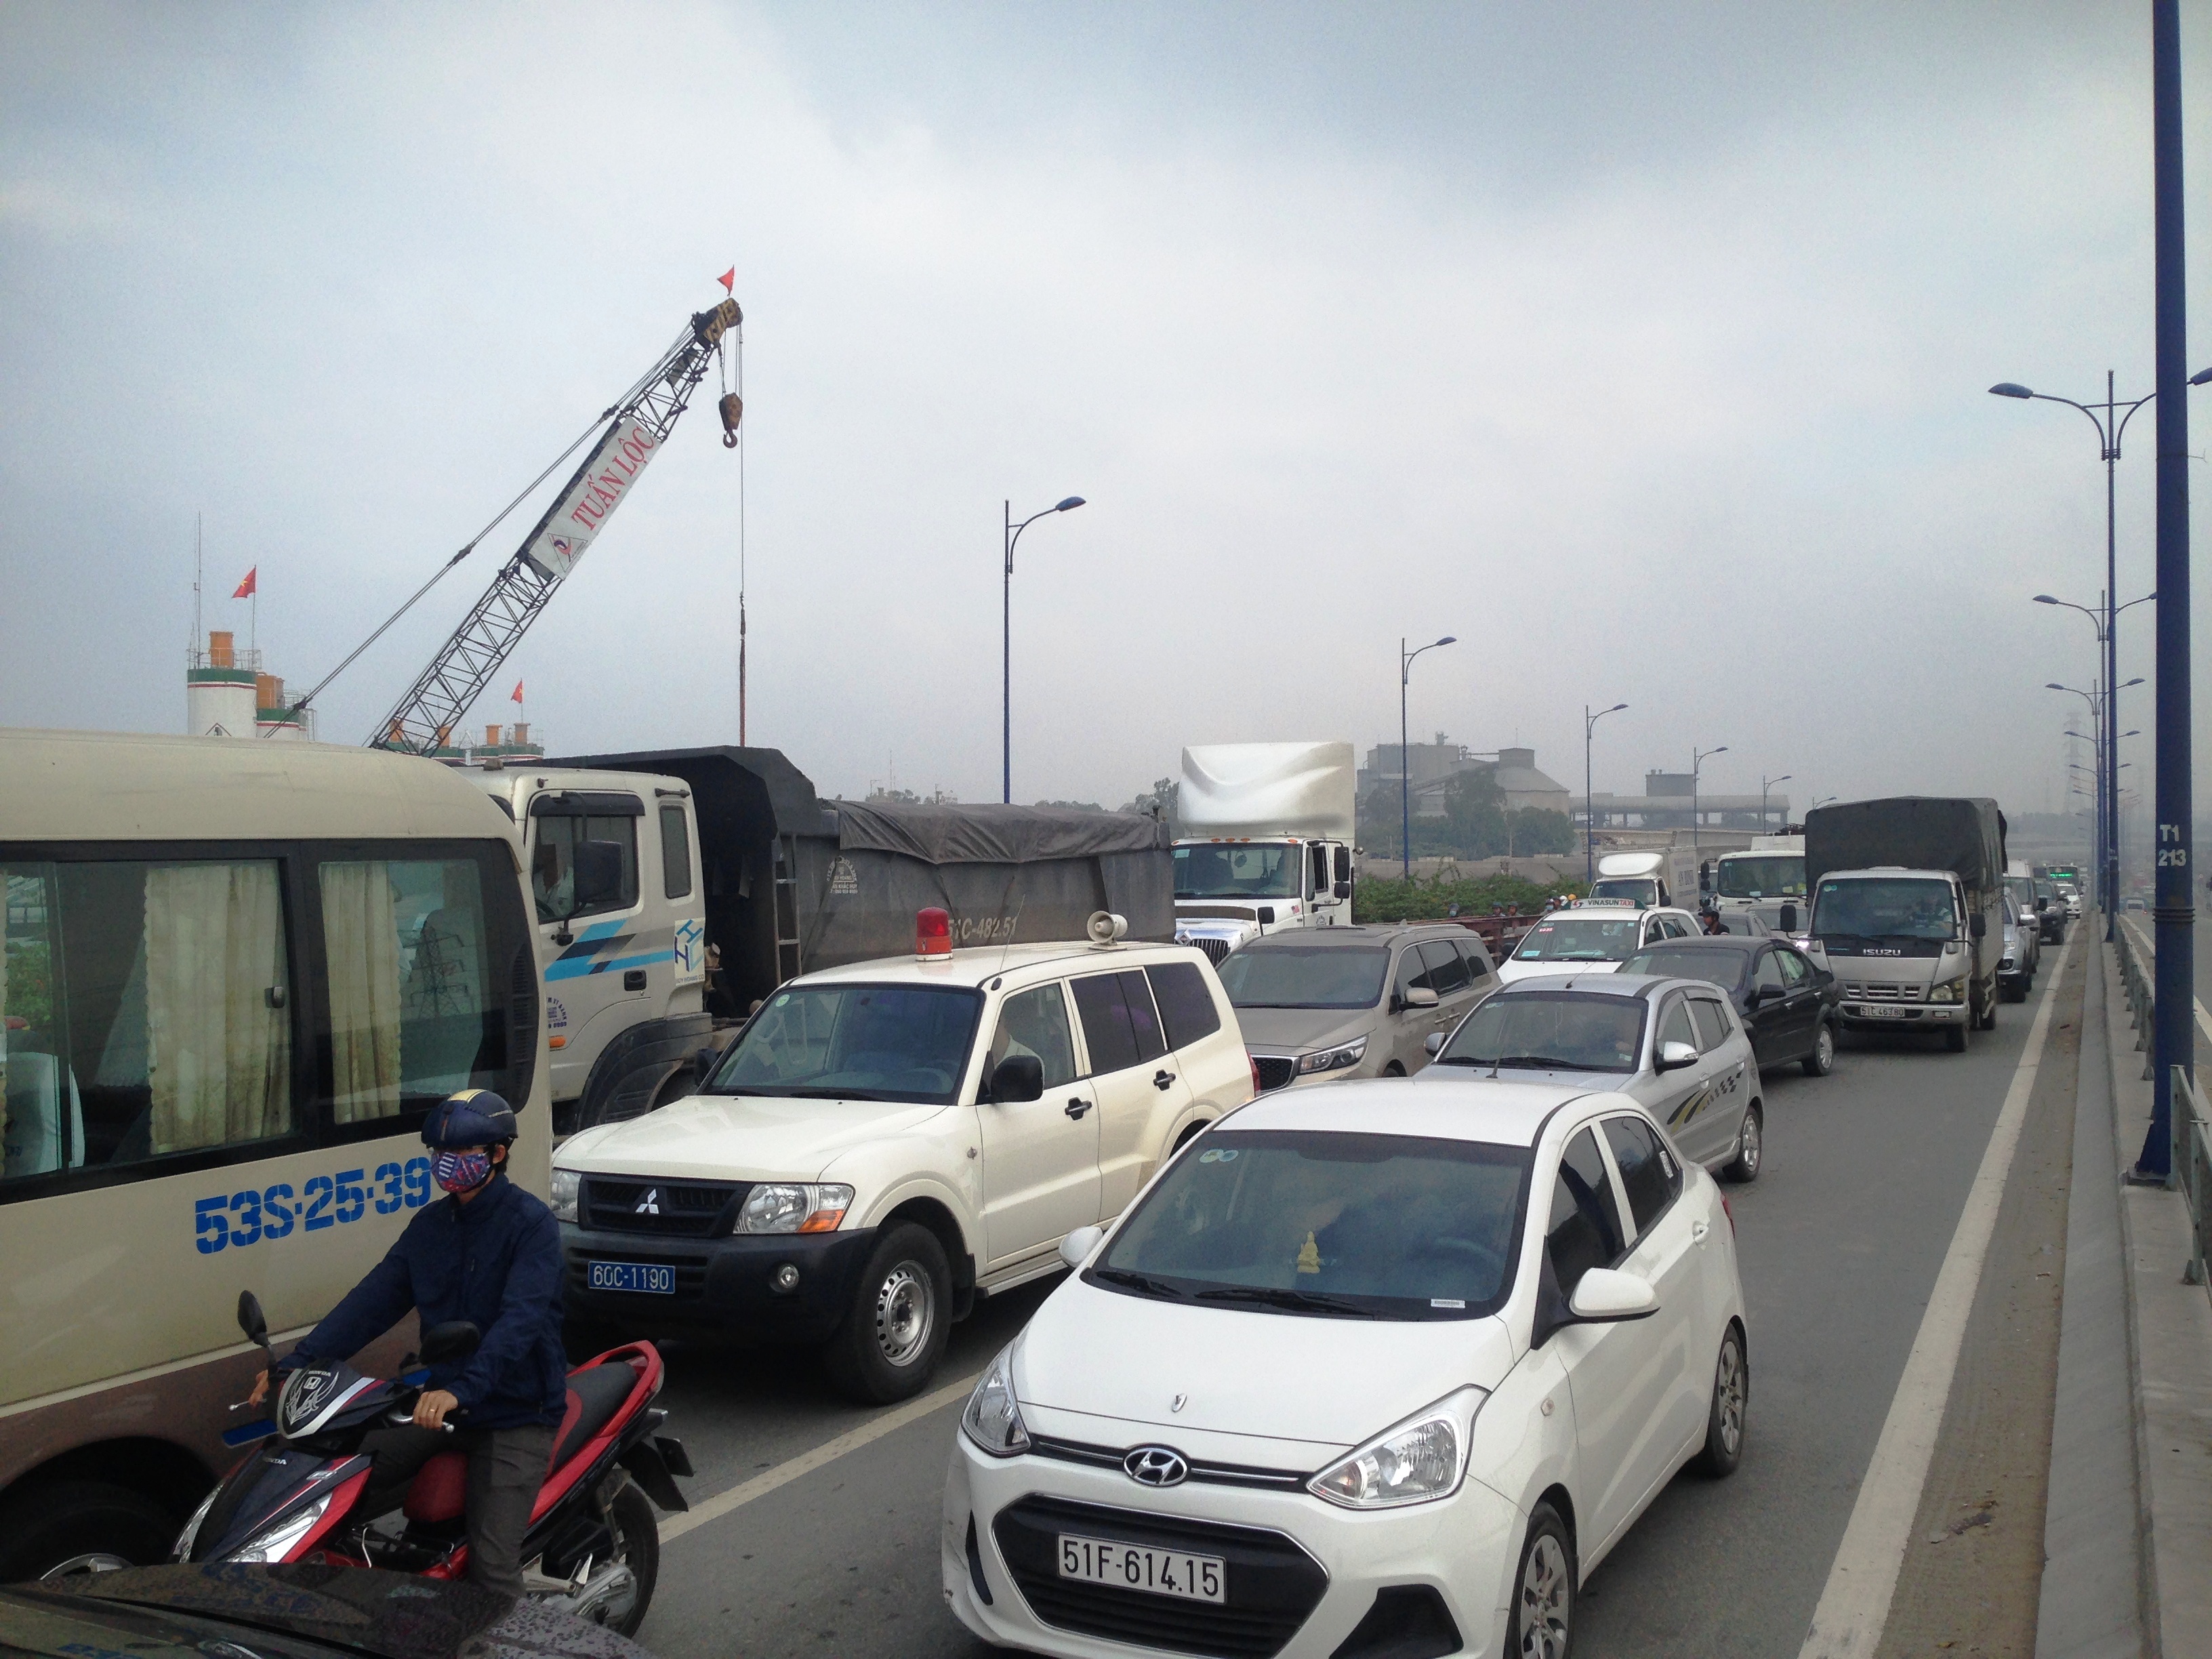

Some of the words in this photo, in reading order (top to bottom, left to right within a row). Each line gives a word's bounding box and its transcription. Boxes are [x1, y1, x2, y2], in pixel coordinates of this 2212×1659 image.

[611, 426, 655, 477] LỘC
[2159, 824, 2179, 842] T1
[2158, 848, 2187, 867] 213
[594, 1265, 669, 1290] 60C-1190
[1063, 1540, 1219, 1597] 51F-614.15
